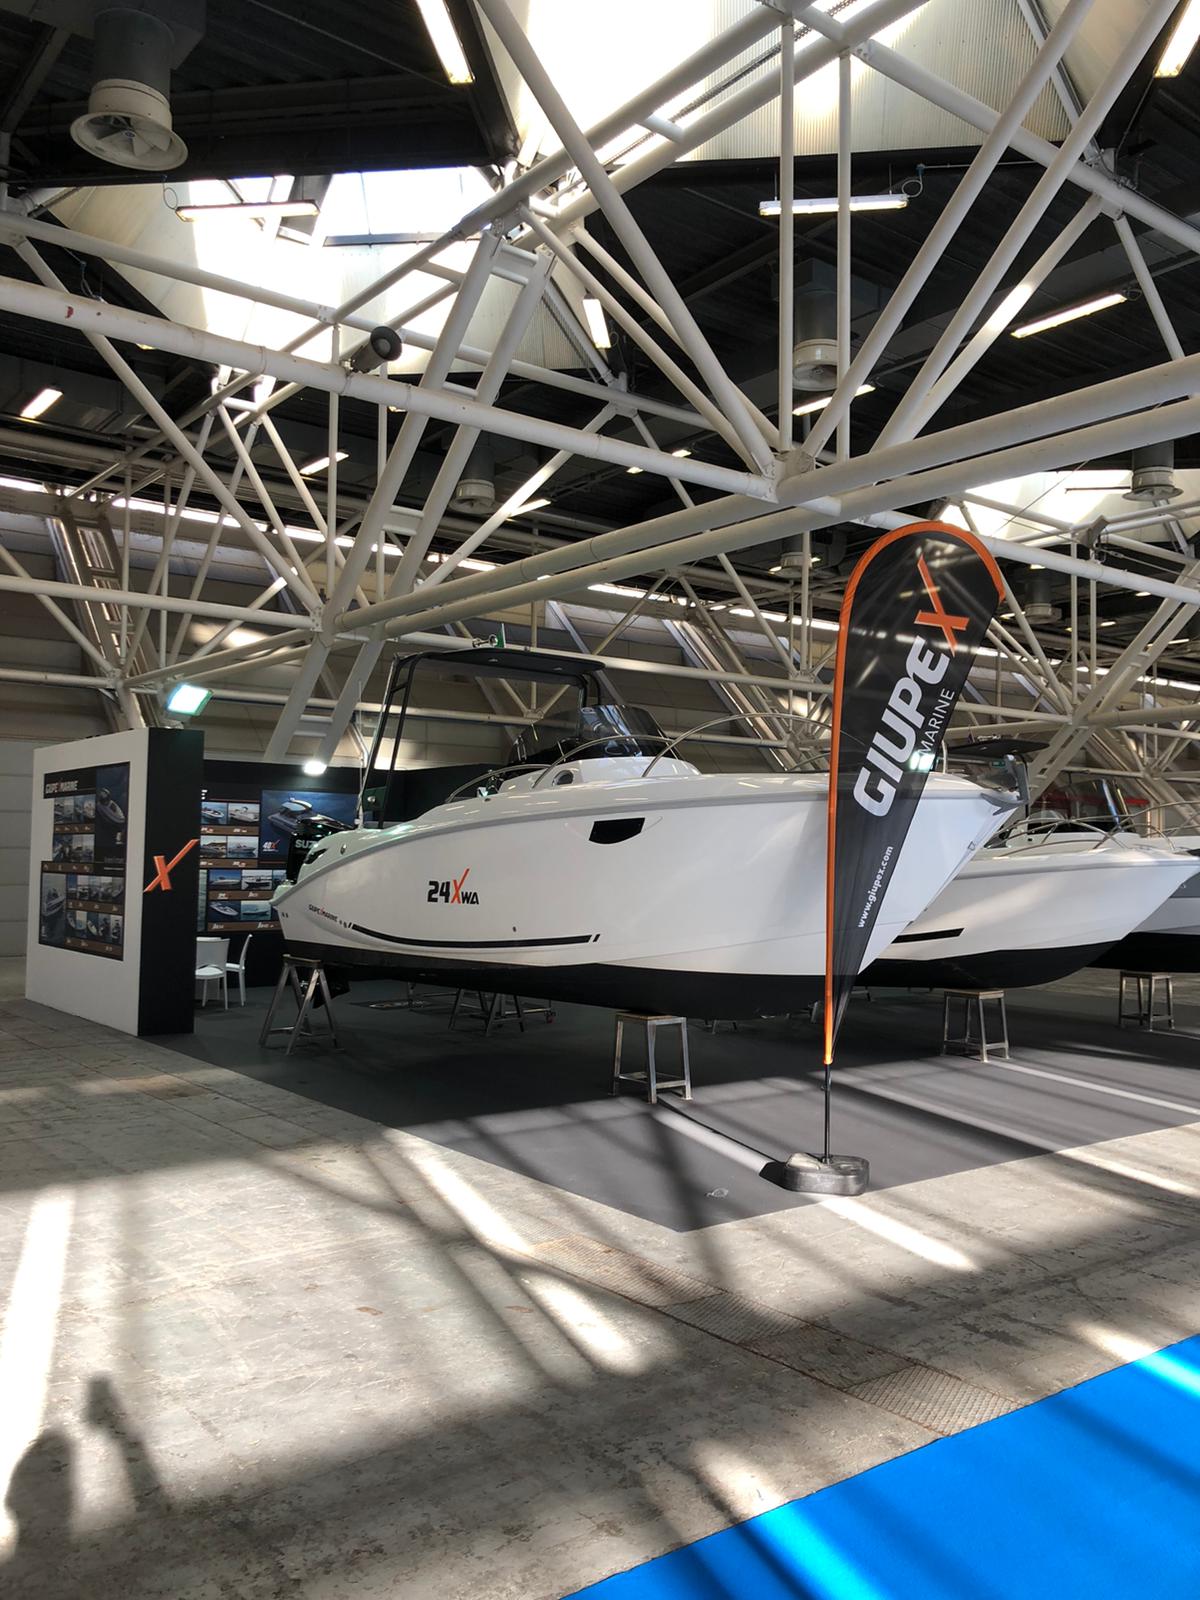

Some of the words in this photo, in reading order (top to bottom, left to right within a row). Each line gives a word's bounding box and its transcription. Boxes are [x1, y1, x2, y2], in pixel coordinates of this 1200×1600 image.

[853, 554, 970, 817] GIUPEX
[920, 688, 955, 757] MARINE
[295, 839, 319, 849] SUZ
[858, 846, 894, 928] www.giupex.com
